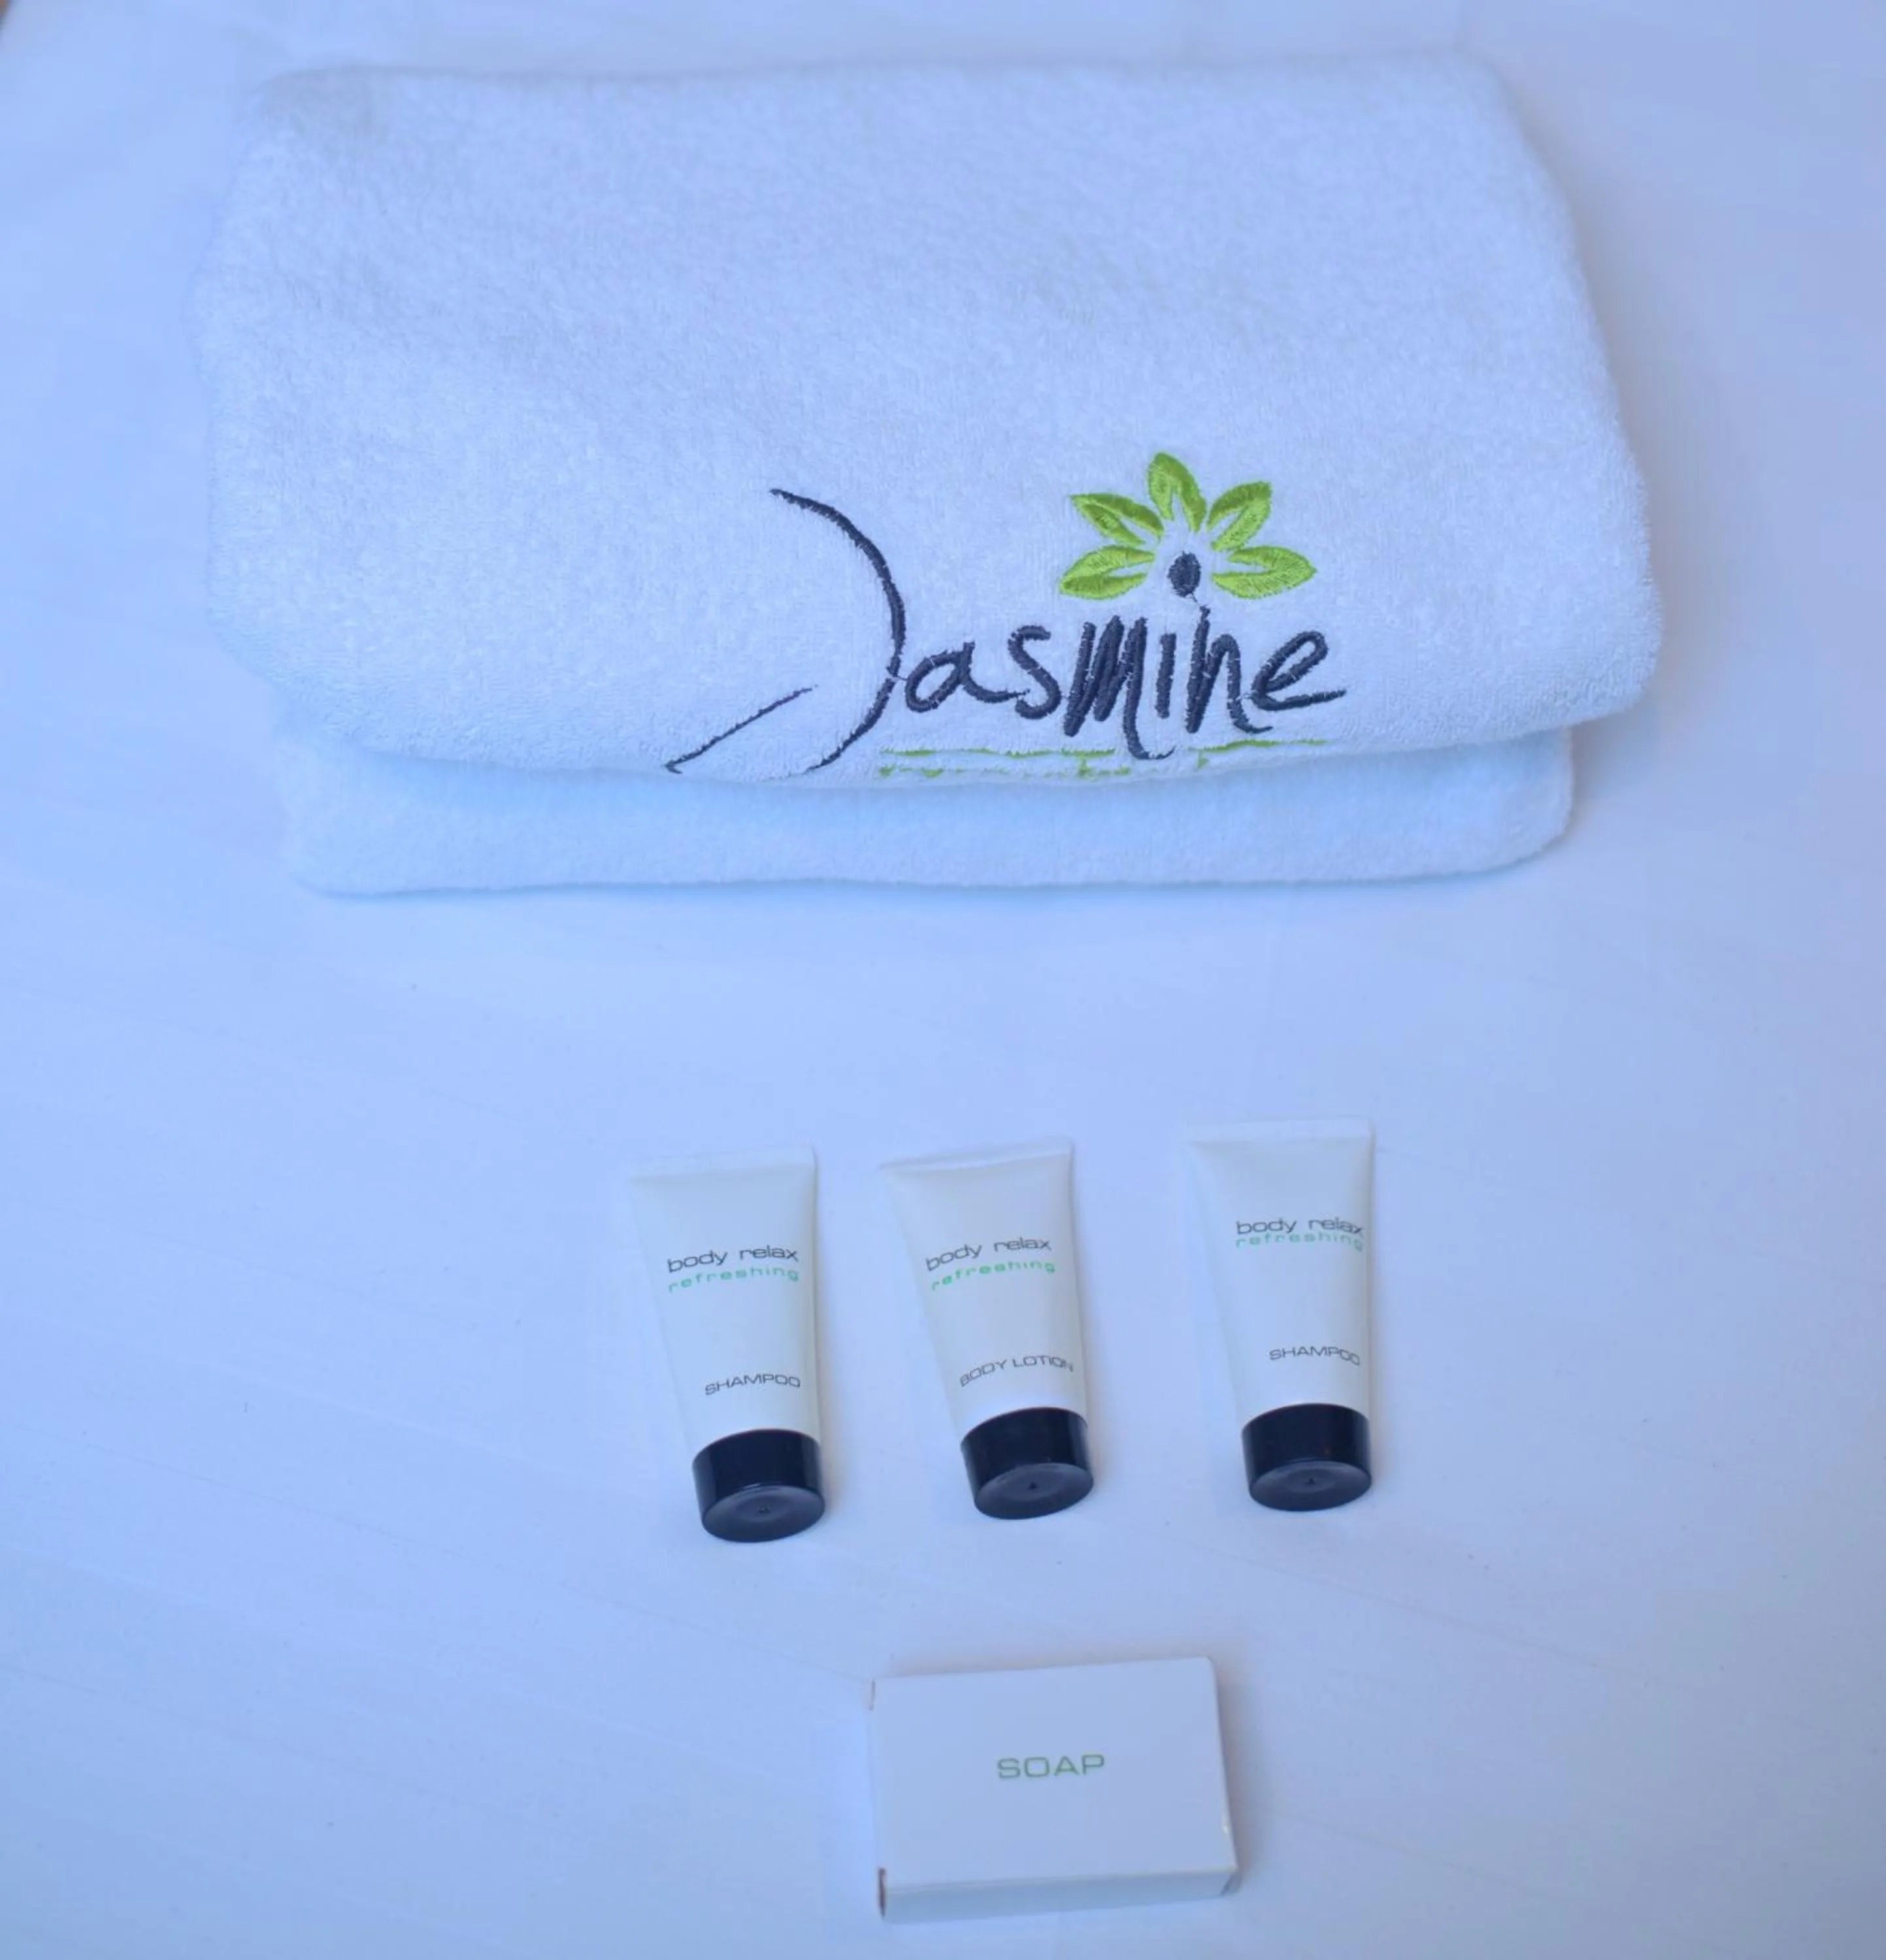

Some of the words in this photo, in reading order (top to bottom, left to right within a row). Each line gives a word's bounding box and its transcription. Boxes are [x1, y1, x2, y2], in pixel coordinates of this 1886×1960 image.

[665, 489, 1346, 774] Jasmine
[1236, 1218, 1297, 1235] body
[1308, 1217, 1365, 1236] relax
[925, 1243, 982, 1271] body
[994, 1237, 1052, 1252] relax
[1235, 1232, 1364, 1252] refreshing
[667, 1250, 728, 1273] body
[739, 1245, 799, 1261] relax
[669, 1267, 799, 1292] refreshing
[931, 1260, 1056, 1291] refreshing
[1269, 1346, 1361, 1366] SHAMPOO
[960, 1359, 1008, 1388] BODY
[1012, 1355, 1074, 1373] LOTION
[705, 1373, 801, 1396] SHAMPOO
[997, 1754, 1105, 1778] SOAP
